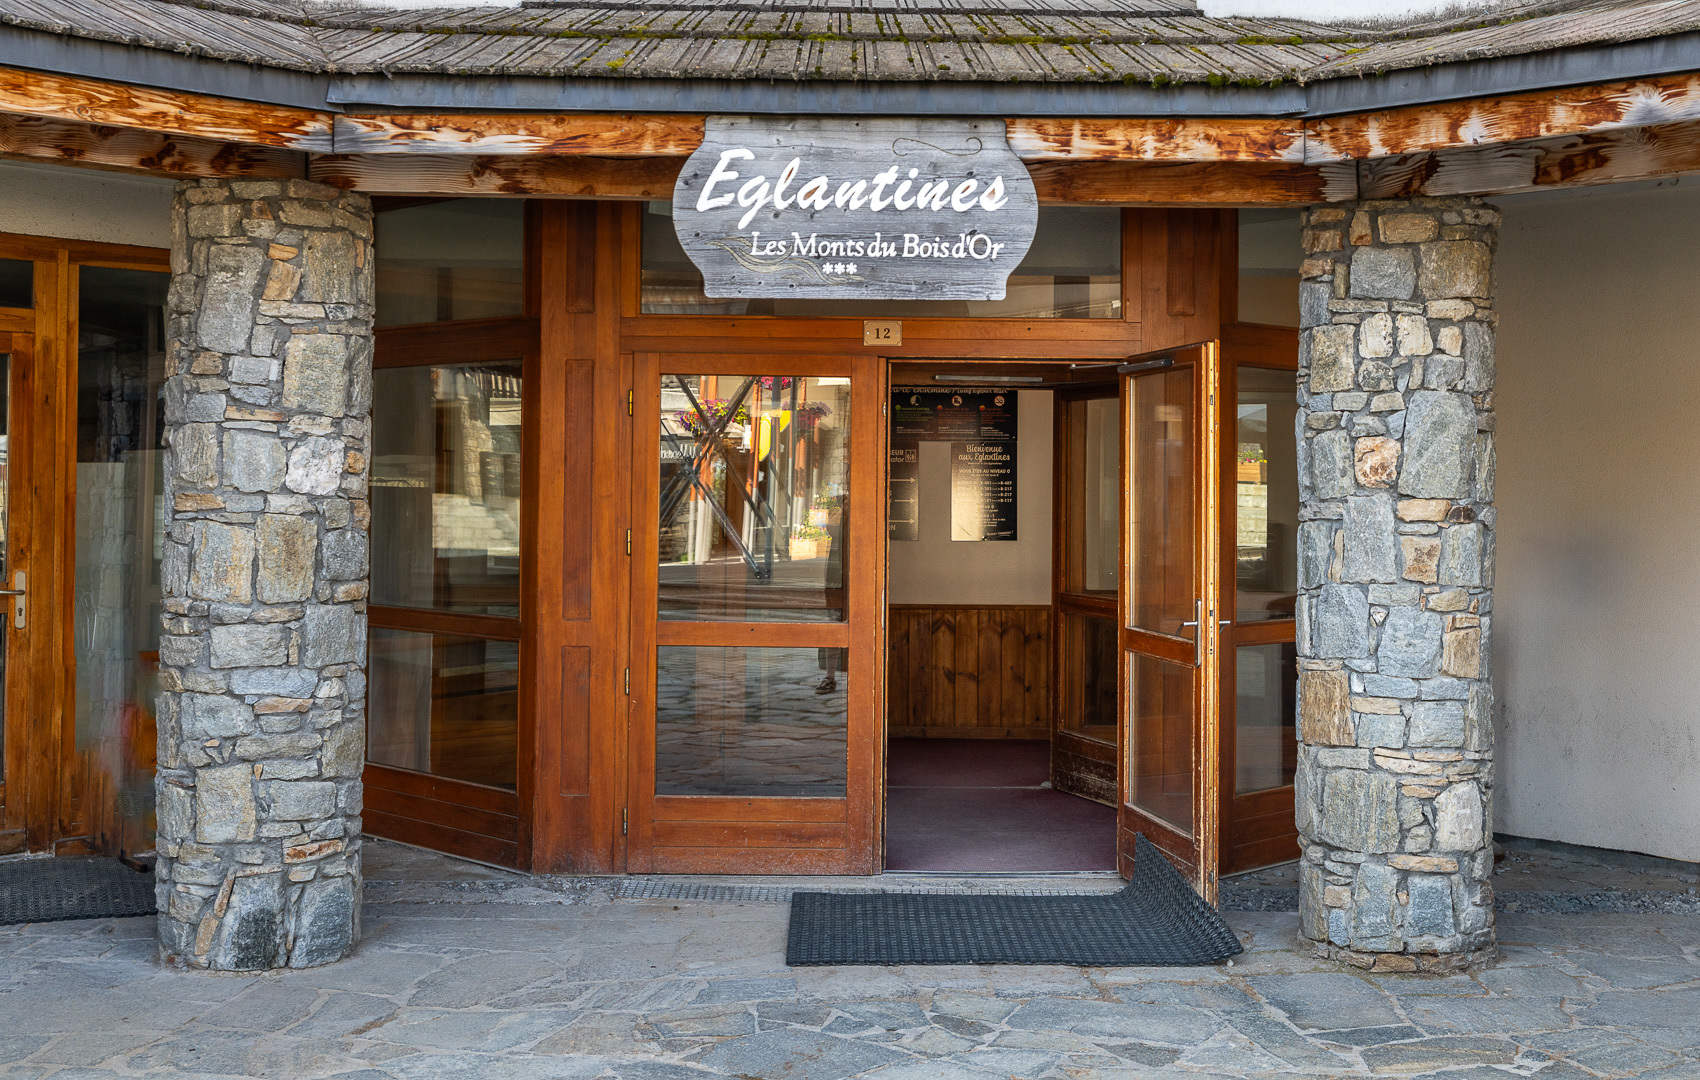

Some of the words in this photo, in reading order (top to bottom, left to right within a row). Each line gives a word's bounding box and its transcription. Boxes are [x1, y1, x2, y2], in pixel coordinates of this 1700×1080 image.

[696, 148, 1009, 230] Eglantines
[750, 231, 786, 257] Les
[791, 232, 865, 258] Monts
[866, 232, 897, 258] du
[902, 233, 950, 259] Bois
[951, 233, 1005, 260] d'Or
[874, 327, 891, 339] 12
[966, 443, 1004, 453] Bienvenue
